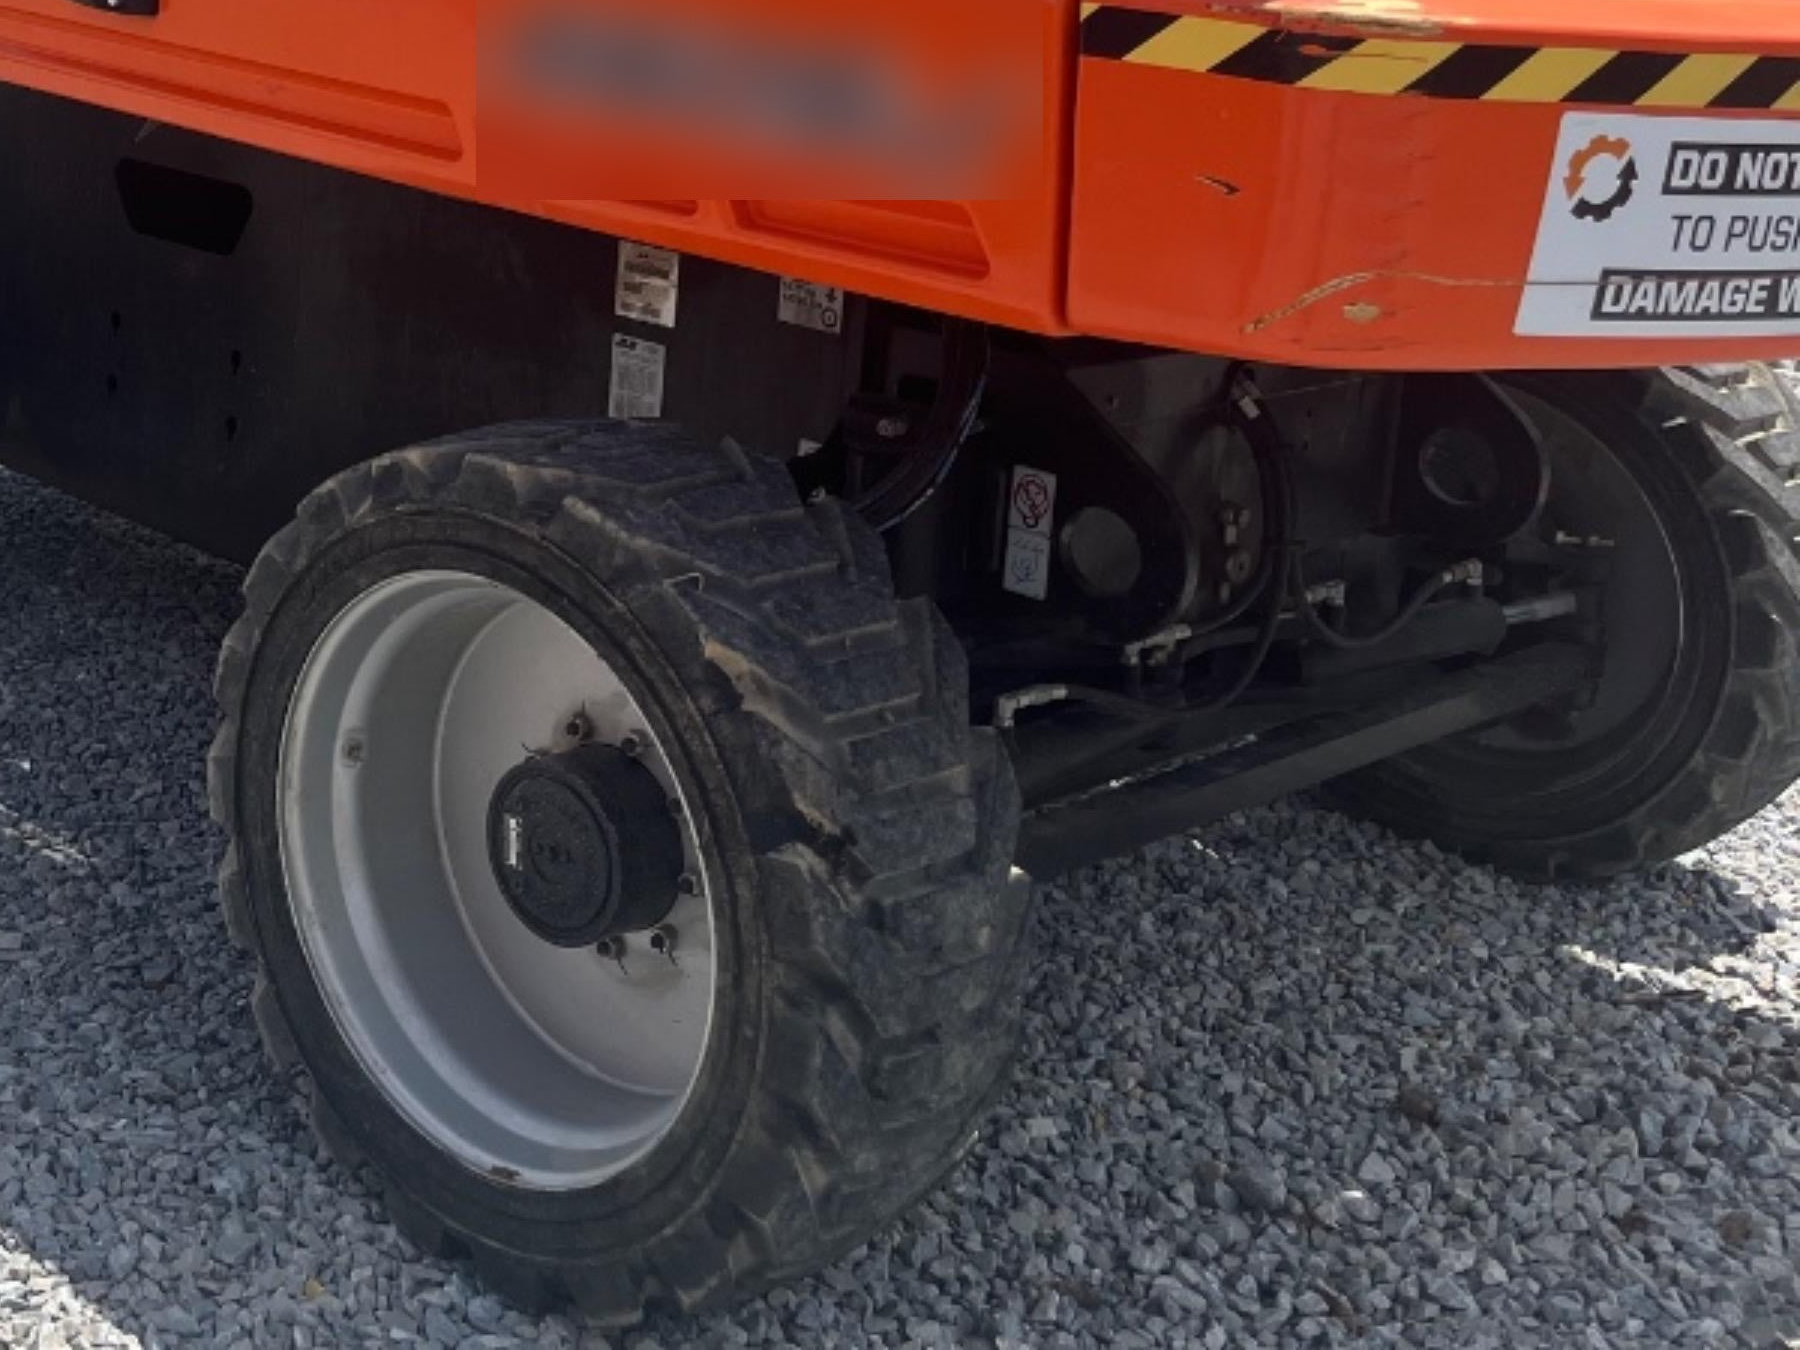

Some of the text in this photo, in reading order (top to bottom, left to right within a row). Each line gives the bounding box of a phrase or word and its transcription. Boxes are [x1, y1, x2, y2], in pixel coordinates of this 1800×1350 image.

[1670, 149, 1729, 189] DO
[1670, 214, 1717, 253] TO
[1600, 275, 1772, 314] DAMAGE
